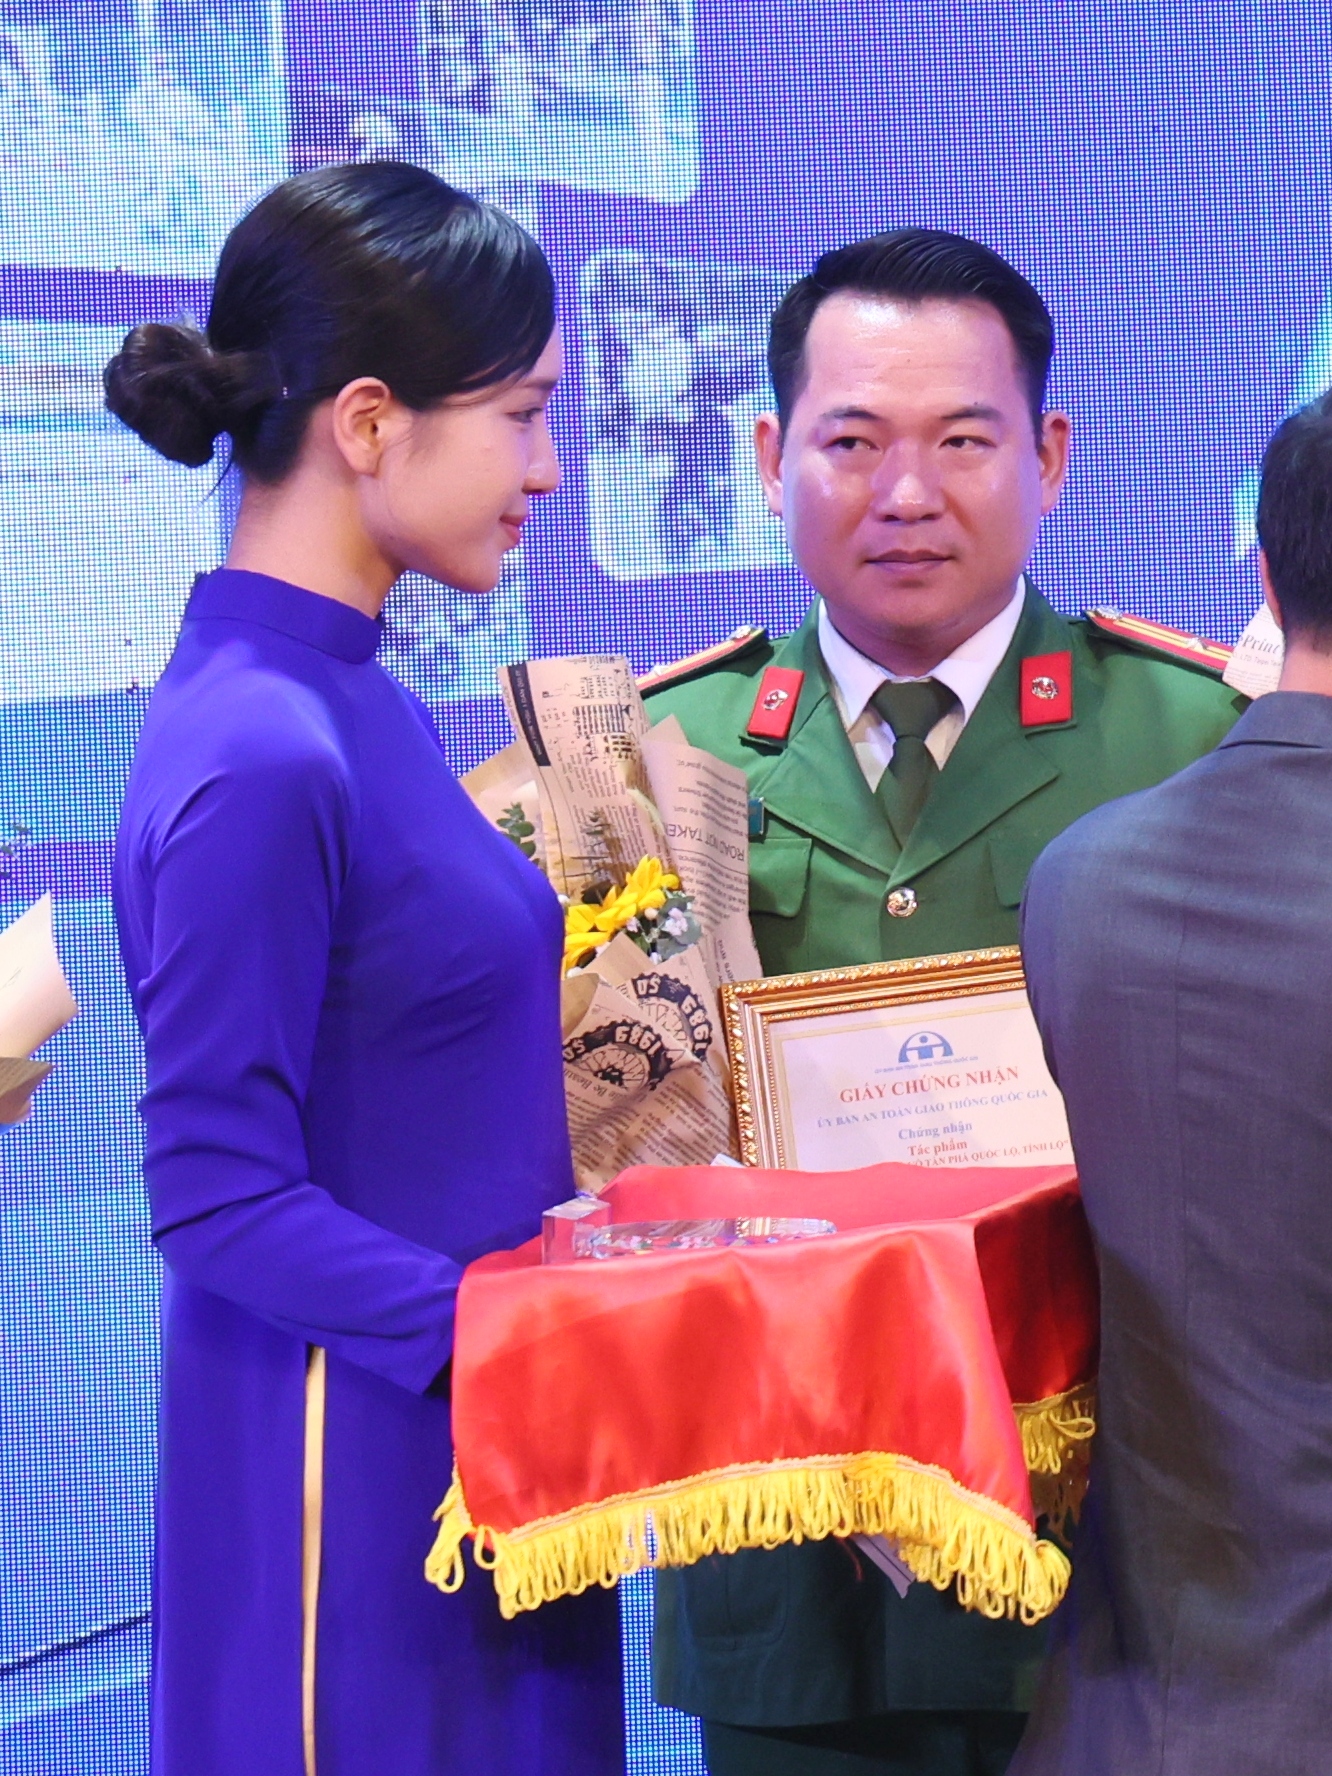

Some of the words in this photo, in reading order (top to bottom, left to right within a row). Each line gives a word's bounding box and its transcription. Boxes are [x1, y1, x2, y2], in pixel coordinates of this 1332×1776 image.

[839, 1081, 886, 1102] GIẤY
[890, 1072, 960, 1096] CHỨNG
[965, 1065, 1019, 1087] NHẬN
[836, 1114, 859, 1125] BAN
[862, 1112, 878, 1122] AN
[914, 1102, 944, 1114] GIAO
[948, 1095, 988, 1109] THÔNG
[1026, 1089, 1048, 1098] GIA
[898, 1125, 940, 1140] Chứng
[942, 1120, 972, 1135] nhận
[907, 1144, 930, 1156] Tác
[932, 1136, 968, 1155] phẩm
